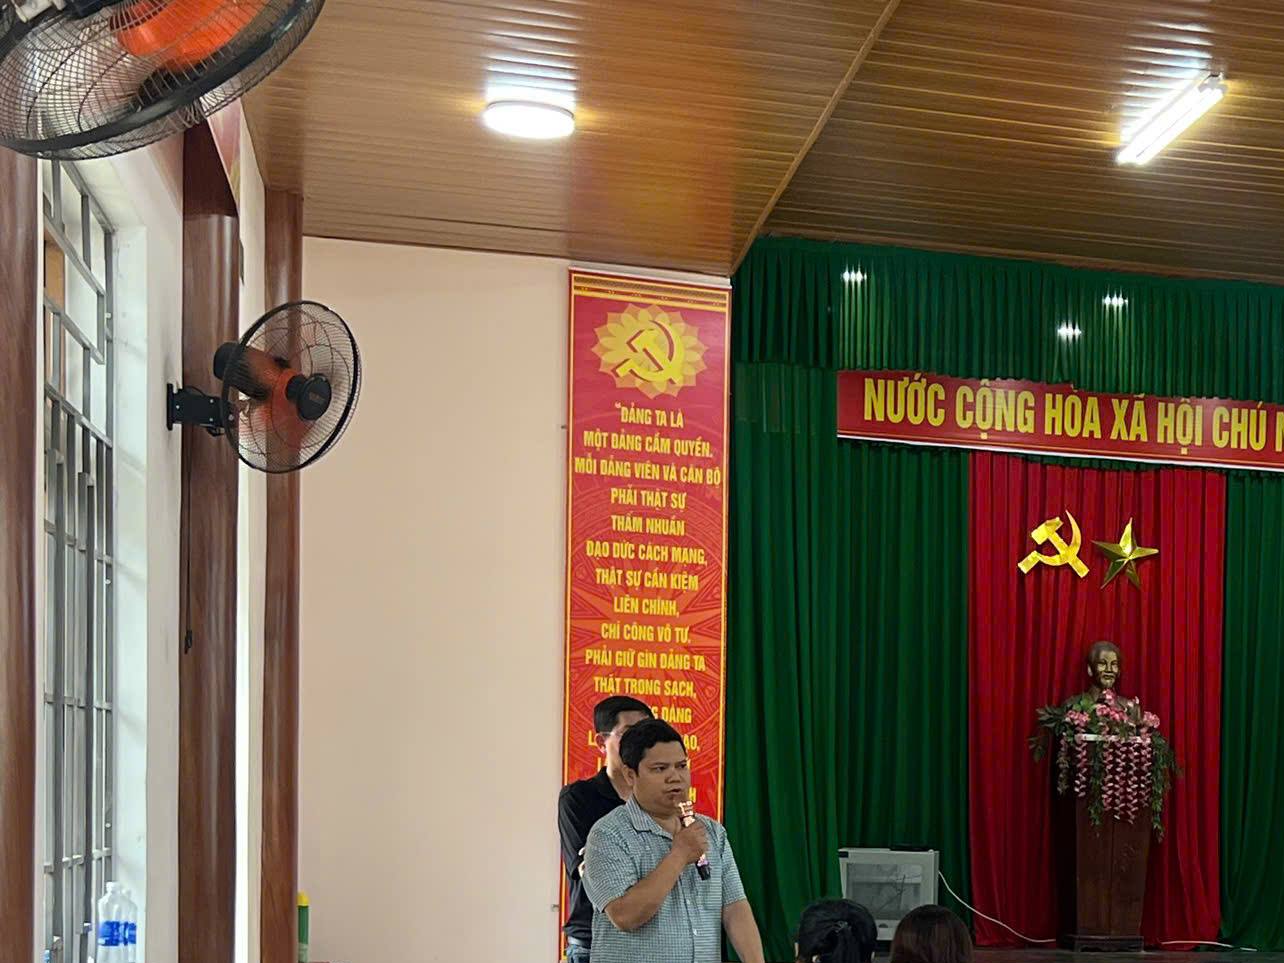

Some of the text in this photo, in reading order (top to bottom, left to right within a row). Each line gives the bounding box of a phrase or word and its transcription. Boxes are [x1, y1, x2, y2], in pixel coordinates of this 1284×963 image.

[655, 410, 667, 426] TA
[671, 409, 684, 428] LÀ
[864, 372, 945, 427] NƯỚC
[955, 379, 1035, 440] CỘNG
[1157, 397, 1203, 455] HỘI
[583, 429, 608, 451] MỘT
[611, 429, 642, 451] ĐẢNG
[601, 455, 631, 477] ĐẢNG
[634, 458, 659, 480] VIÊN
[663, 462, 677, 481] VÀ
[611, 484, 687, 513] PHẢI THẬT SỰ
[586, 540, 609, 560] ĐẠO
[613, 540, 635, 559] ĐỨC
[639, 542, 669, 561] CÁCH
[595, 566, 622, 588] THẬT
[626, 569, 642, 590] SỰ
[671, 571, 699, 593] KIỆM
[601, 620, 620, 639] CHÍ
[623, 621, 654, 641] CÔNG
[657, 624, 672, 643] VÔ
[585, 645, 706, 671] PHẢI GIỮ GÌN ĐẢNG TA
[624, 677, 661, 694] TRONG
